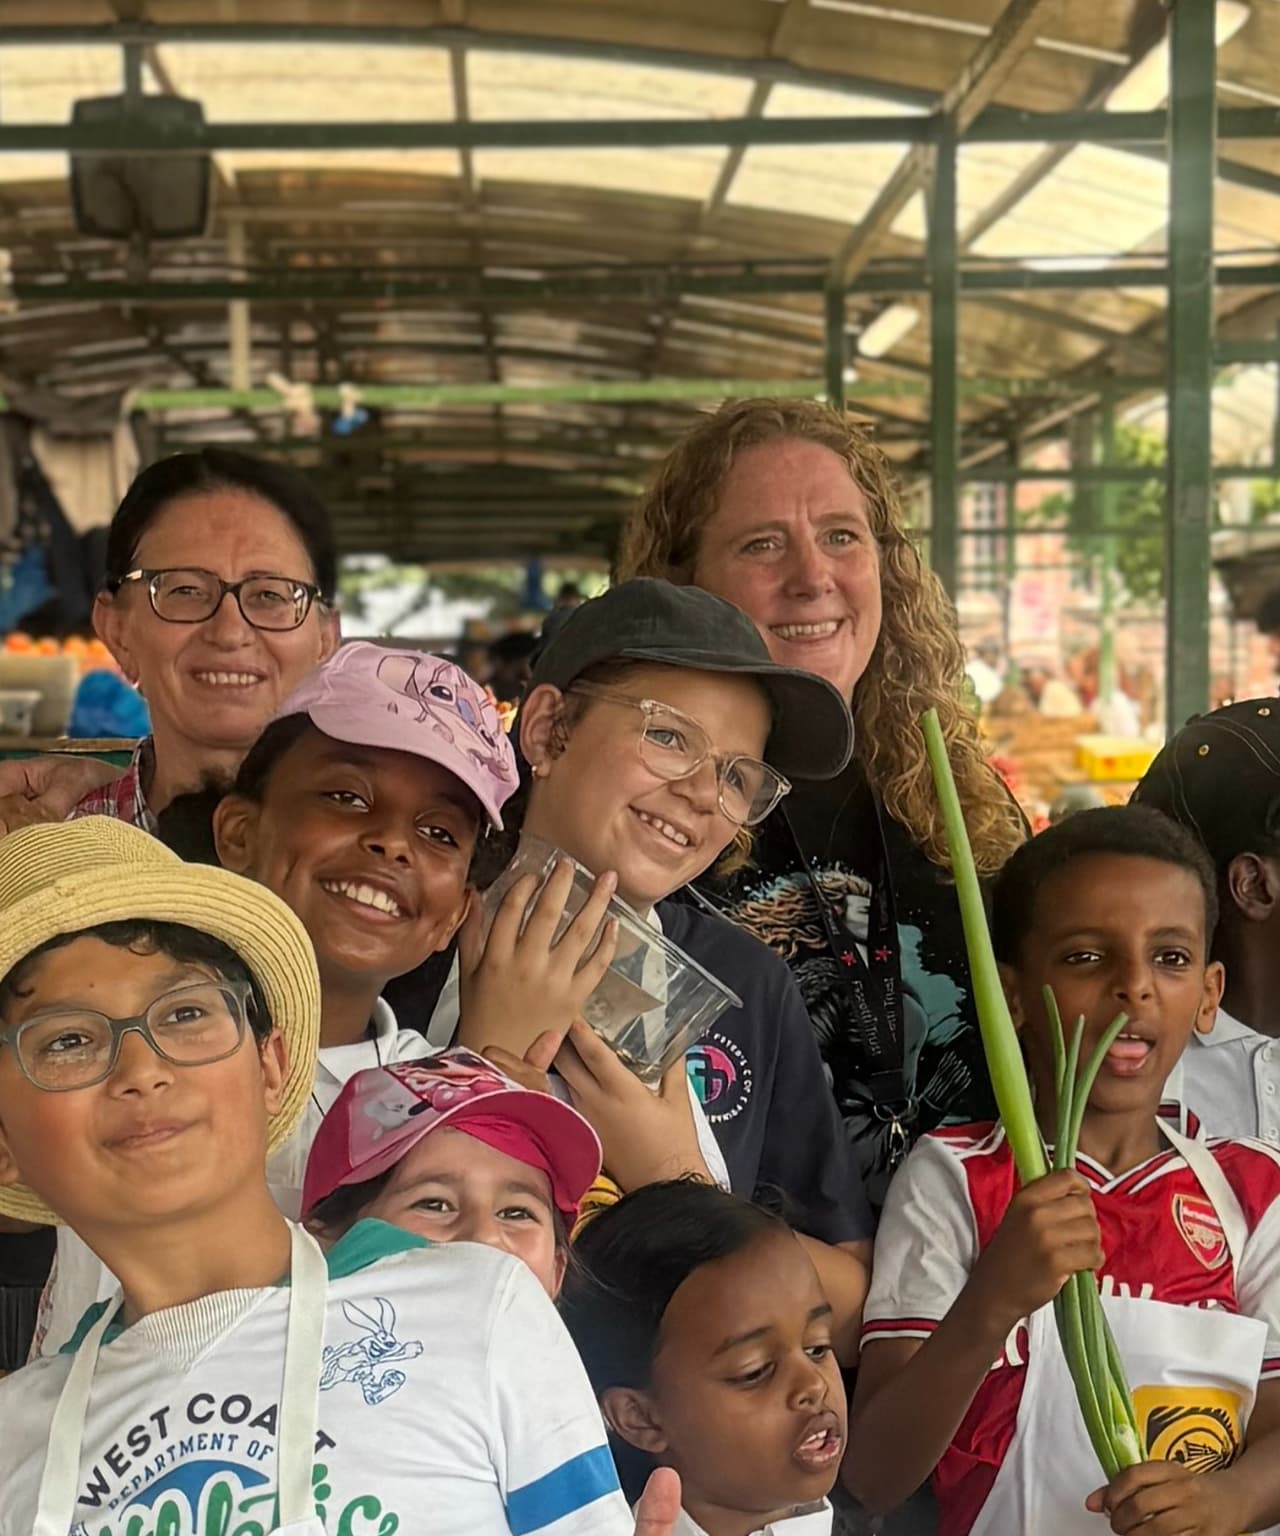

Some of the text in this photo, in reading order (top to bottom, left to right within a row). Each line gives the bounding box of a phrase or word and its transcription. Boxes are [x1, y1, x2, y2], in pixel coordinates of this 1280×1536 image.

[77, 1393, 337, 1509] WEST COAT
[108, 1433, 274, 1511] DEPARTMENT OF
